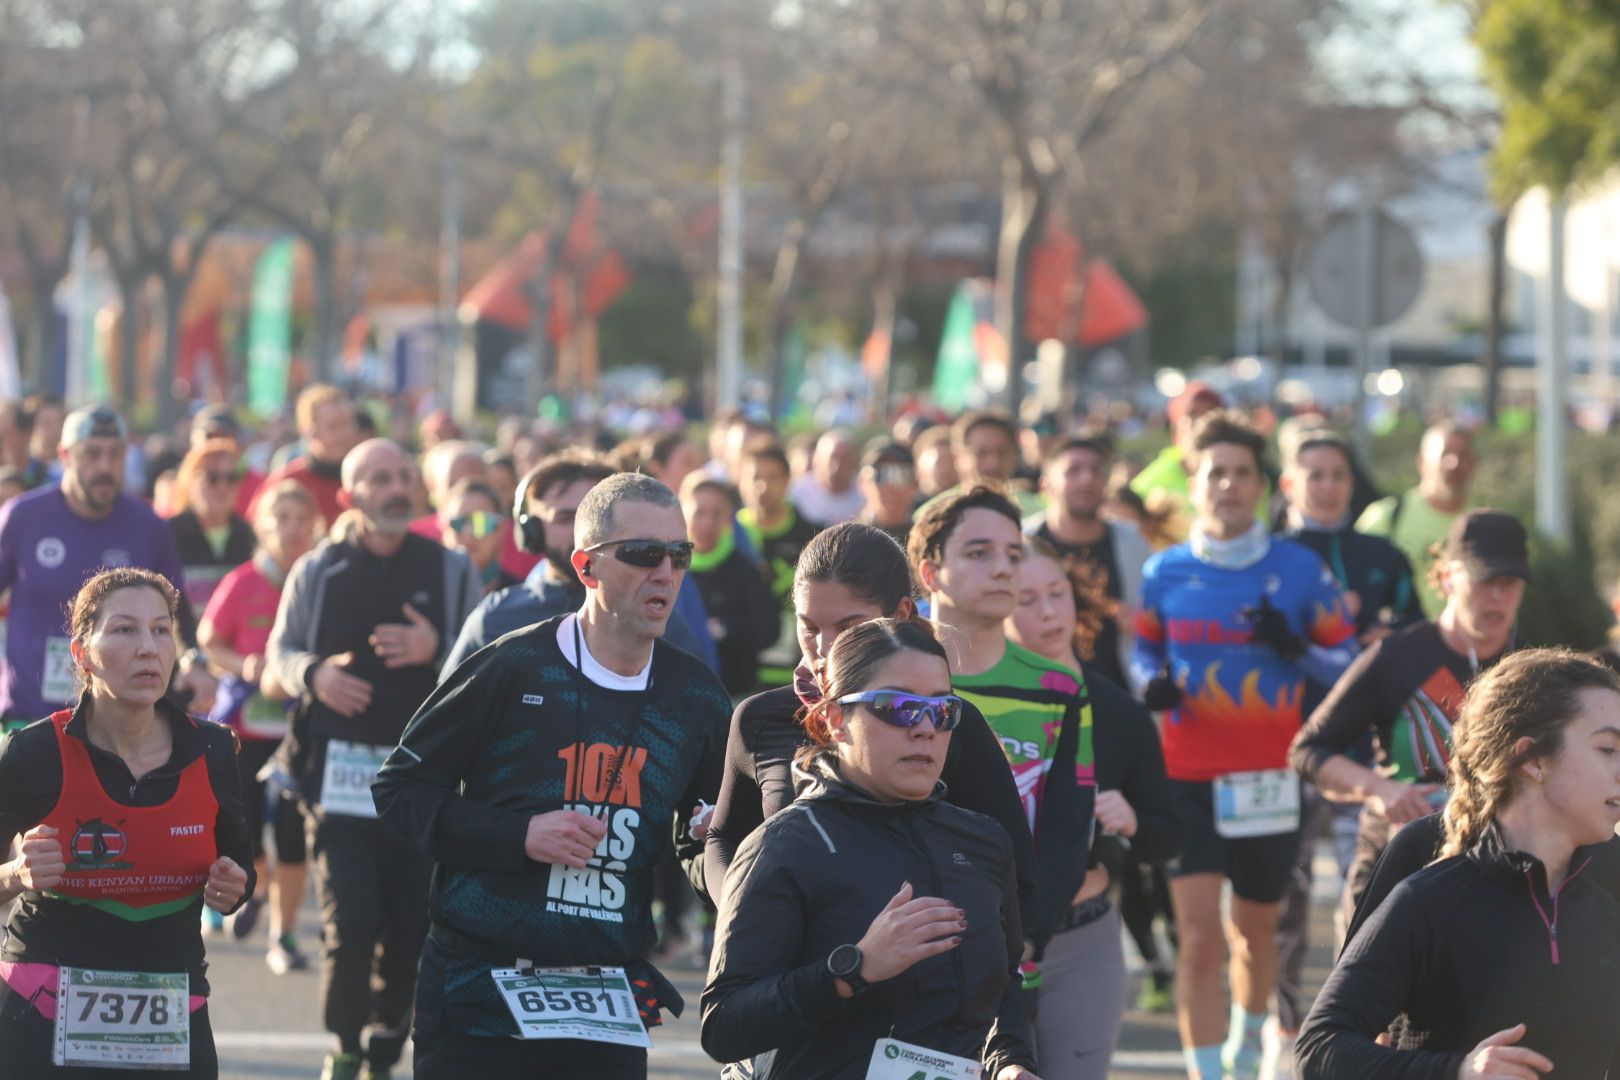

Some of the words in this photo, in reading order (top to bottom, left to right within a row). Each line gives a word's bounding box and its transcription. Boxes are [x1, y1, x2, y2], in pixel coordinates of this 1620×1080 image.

[558, 741, 648, 808] 10K
[170, 824, 204, 837] FASTER
[60, 877, 85, 888] THE
[88, 875, 144, 888] KENYAN
[148, 874, 193, 885] URBAN
[546, 901, 557, 913] AL
[557, 903, 579, 916] PORT
[579, 906, 590, 918] DE
[77, 991, 169, 1026] 7378
[517, 990, 617, 1017] 6581
